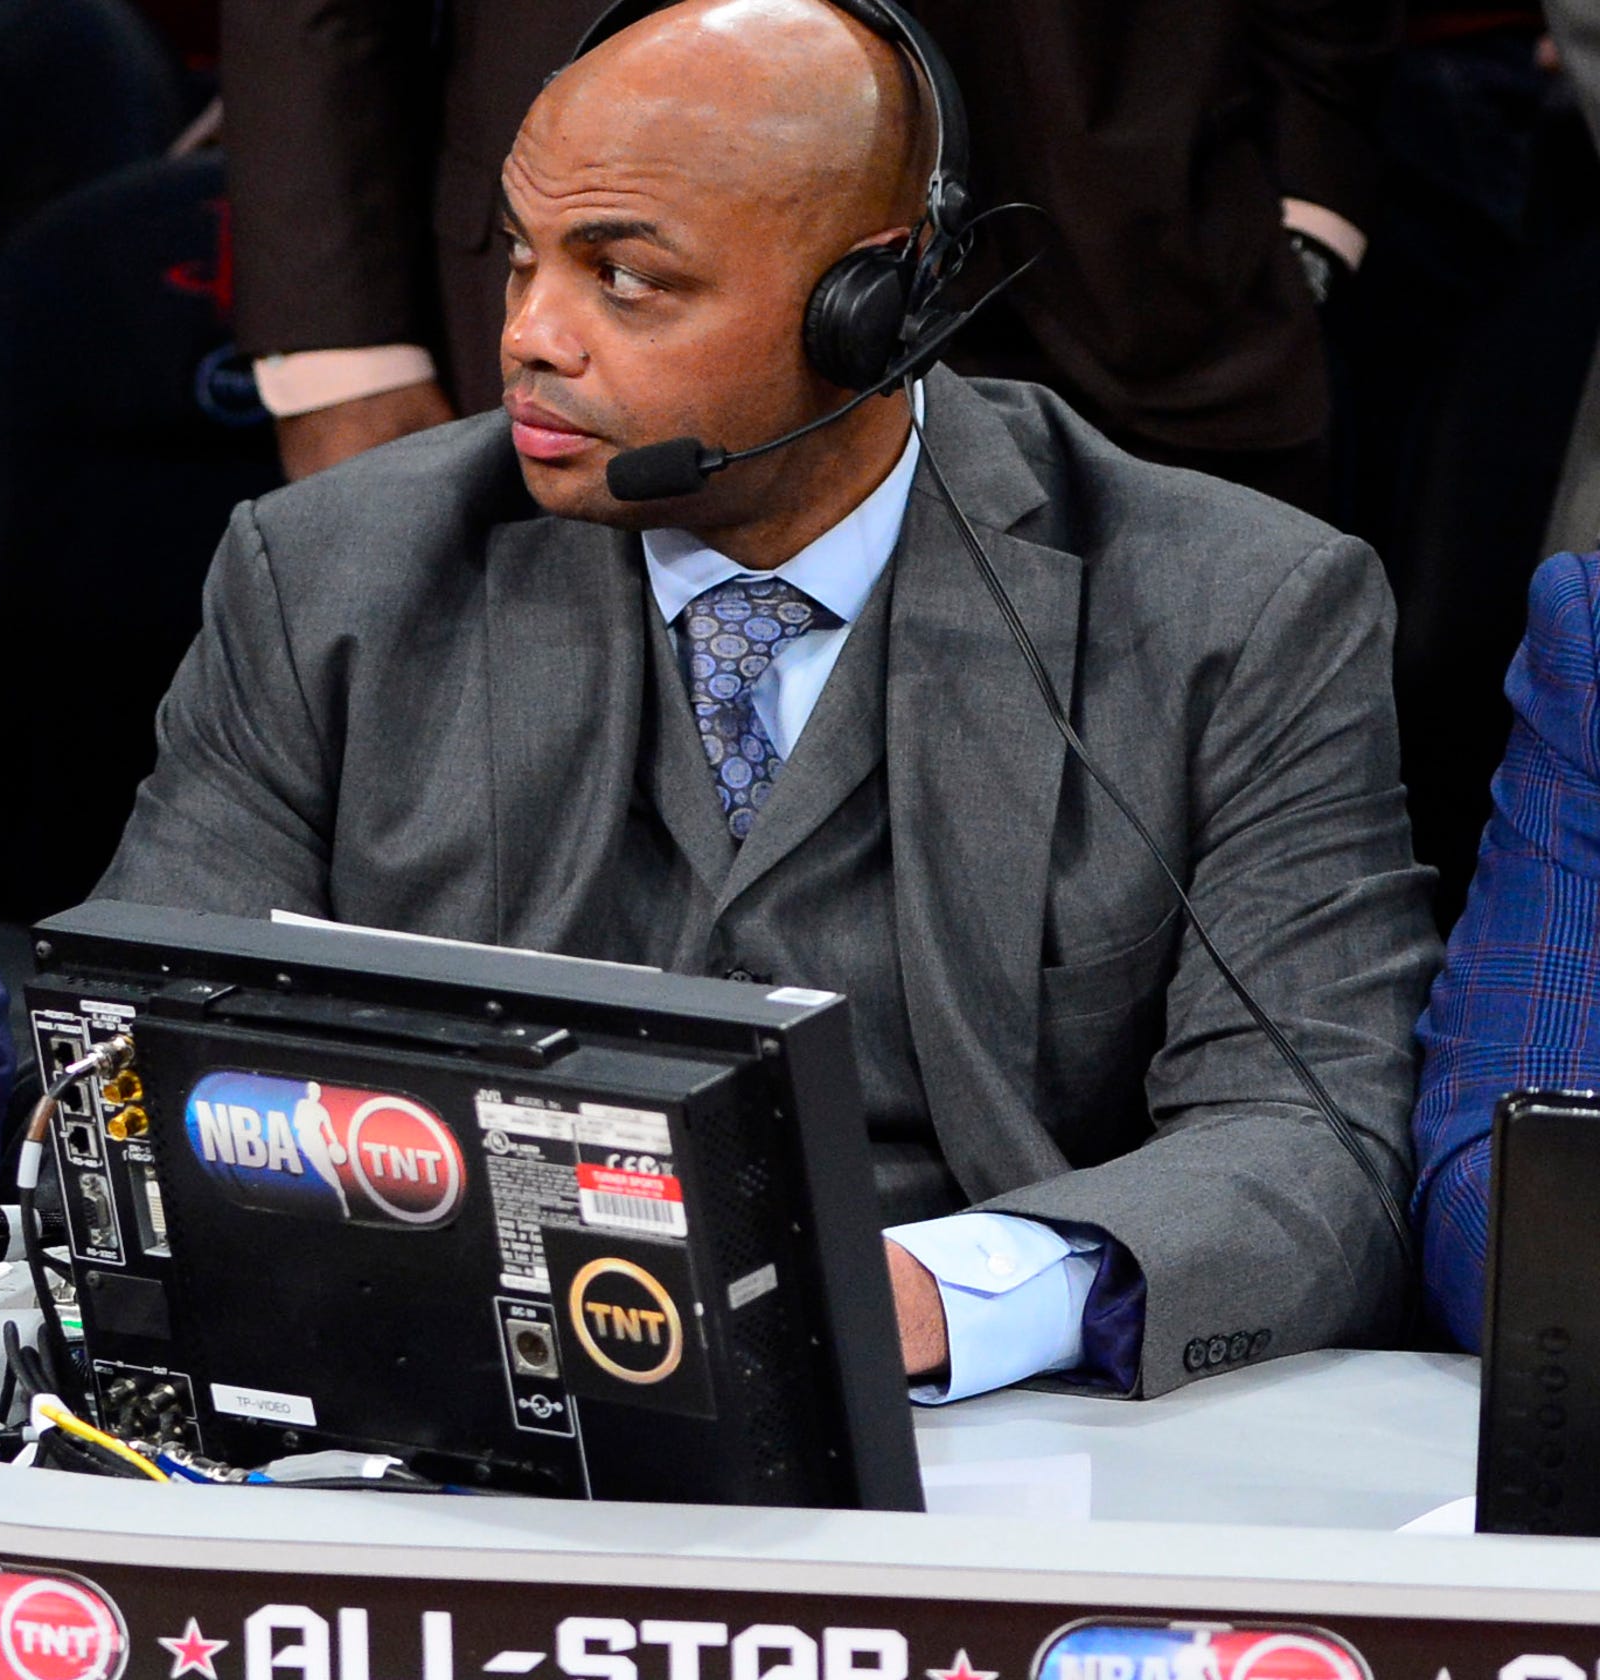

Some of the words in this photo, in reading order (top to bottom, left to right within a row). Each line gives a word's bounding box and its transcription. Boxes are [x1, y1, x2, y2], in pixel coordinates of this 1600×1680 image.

[196, 1100, 303, 1174] NBA
[362, 1142, 441, 1184] TNT
[585, 1302, 665, 1344] TNT
[14, 1619, 96, 1658] TNT
